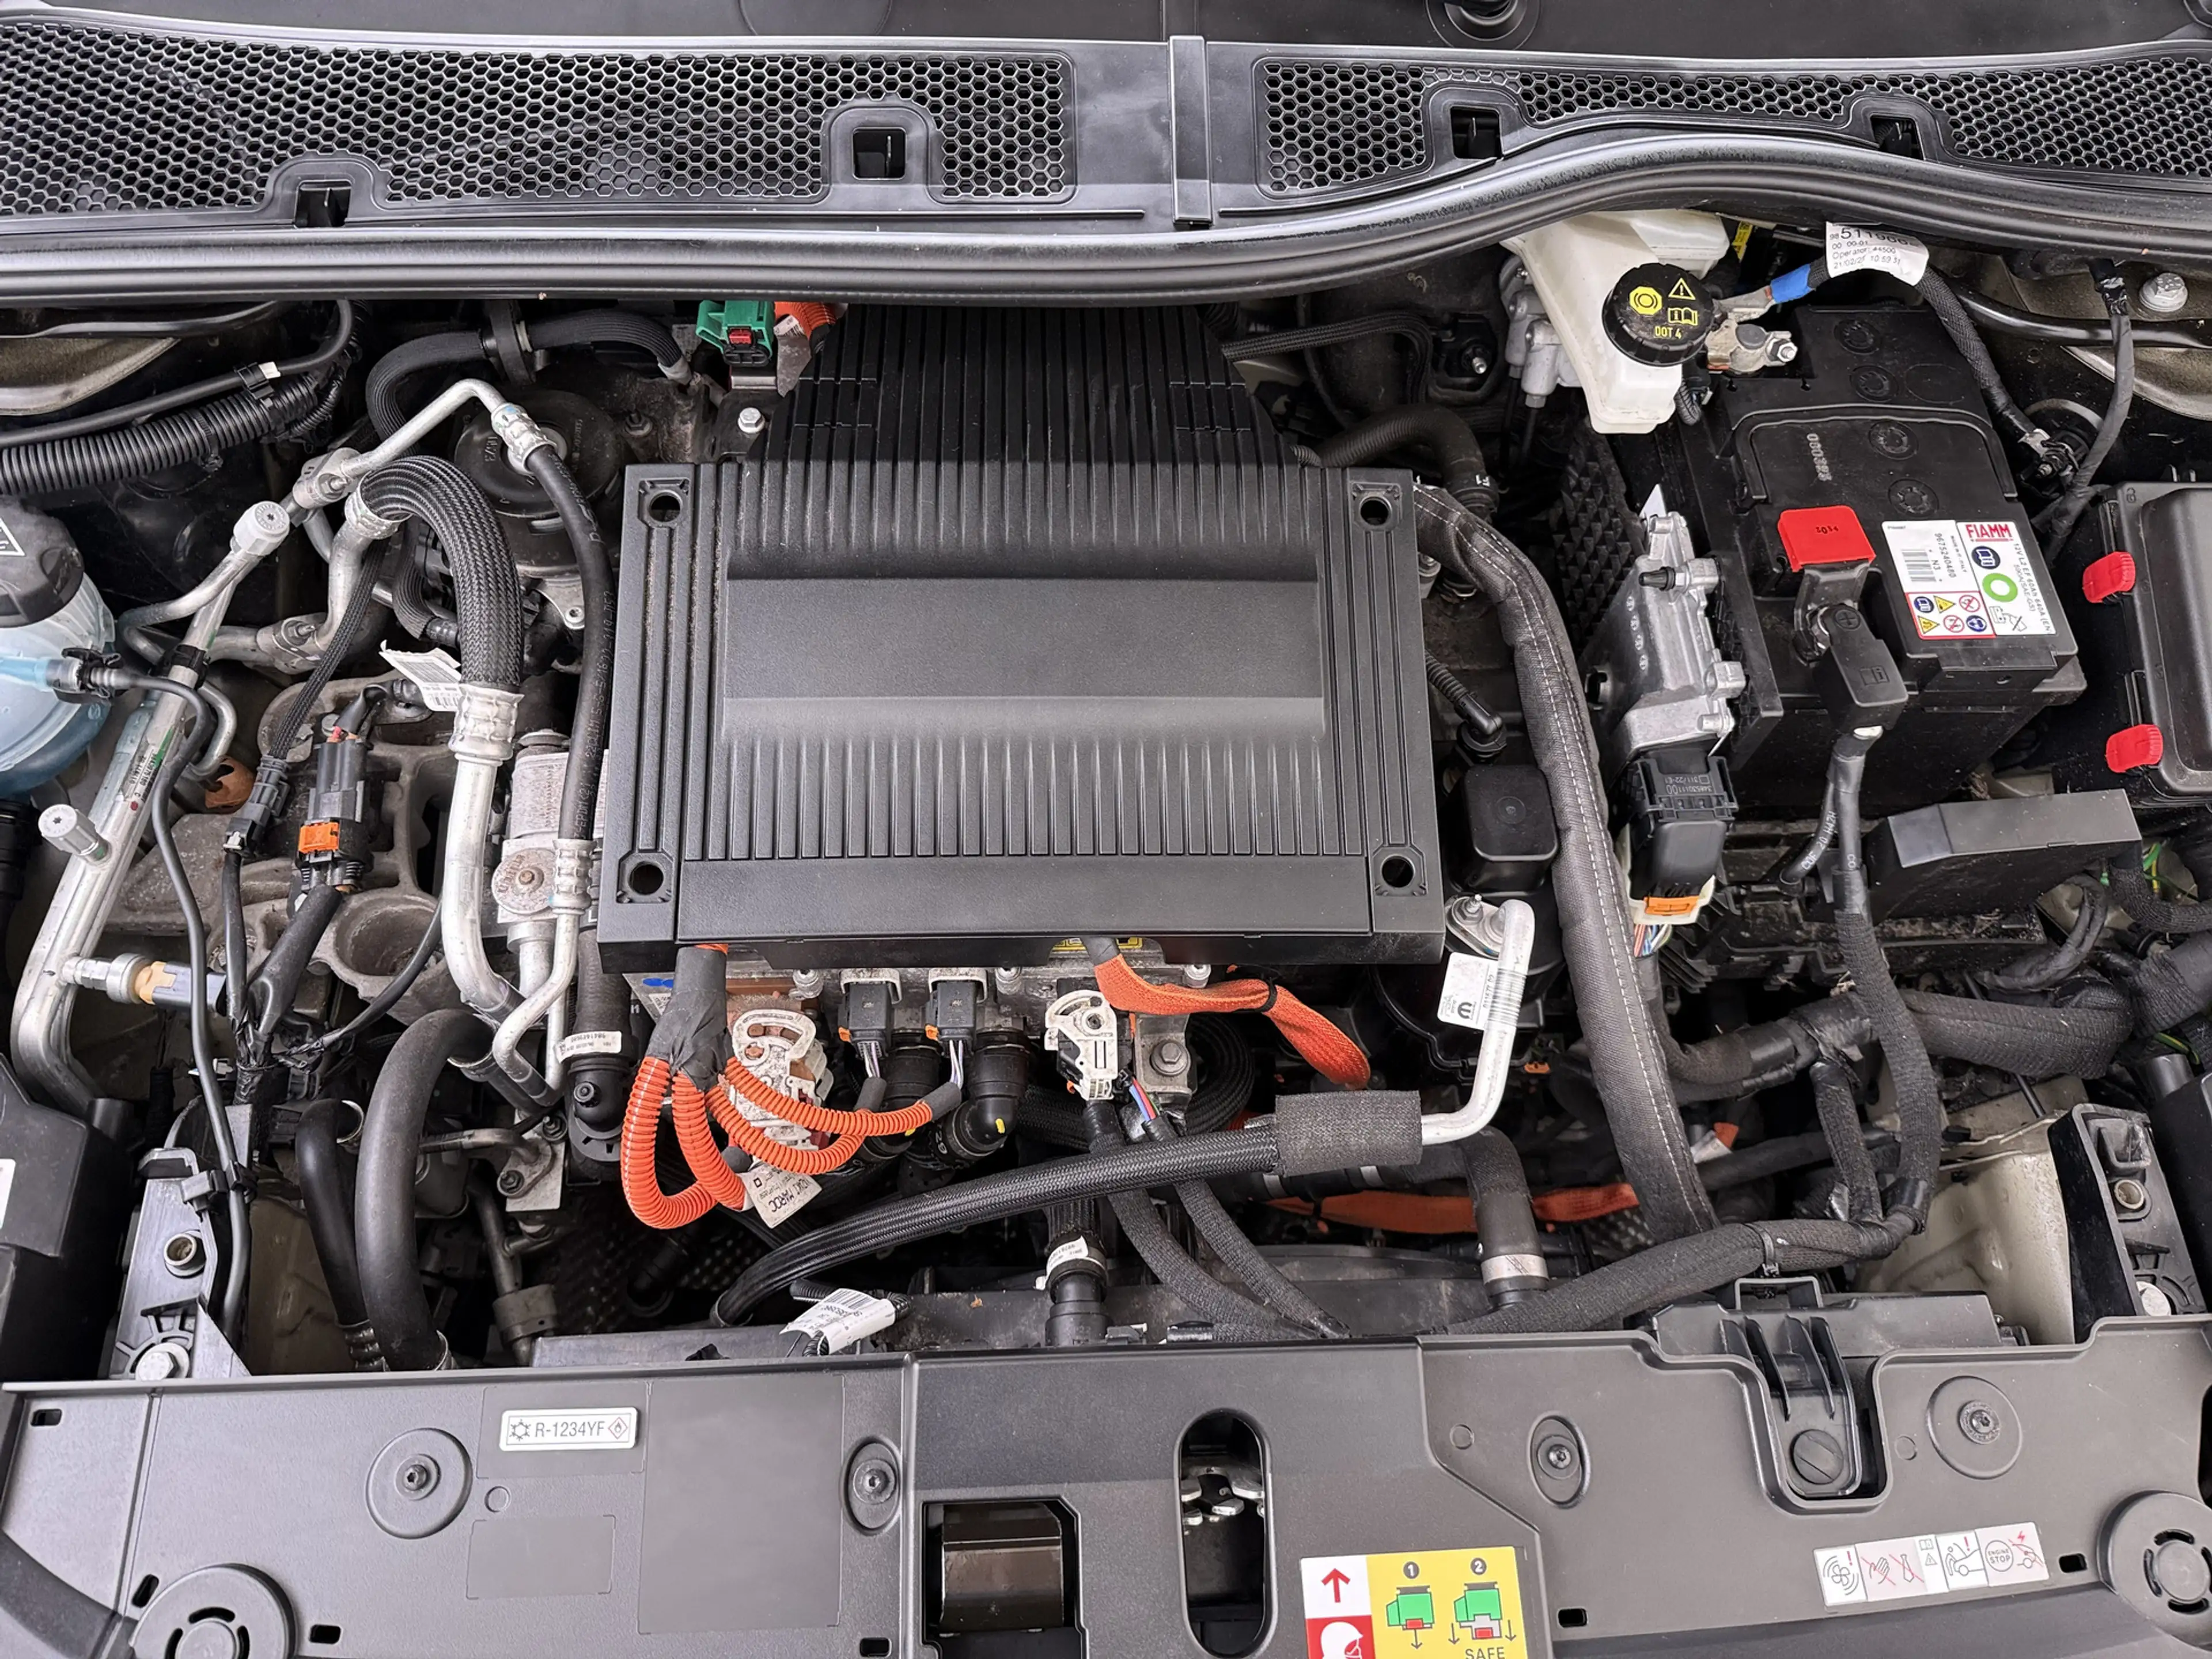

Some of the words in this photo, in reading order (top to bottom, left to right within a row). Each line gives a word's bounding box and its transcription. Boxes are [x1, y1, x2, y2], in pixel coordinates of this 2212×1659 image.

[1654, 325, 1673, 338] DOT
[1675, 327, 1682, 339] 4
[1965, 524, 2013, 538] FIAMM
[768, 1188, 795, 1213] MAROC
[535, 1421, 605, 1438] R-1234YF
[1990, 1554, 2010, 1564] STOP
[1407, 1564, 1415, 1577] 1
[1474, 1560, 1483, 1573] 2
[1465, 1646, 1505, 1659] SAFE
